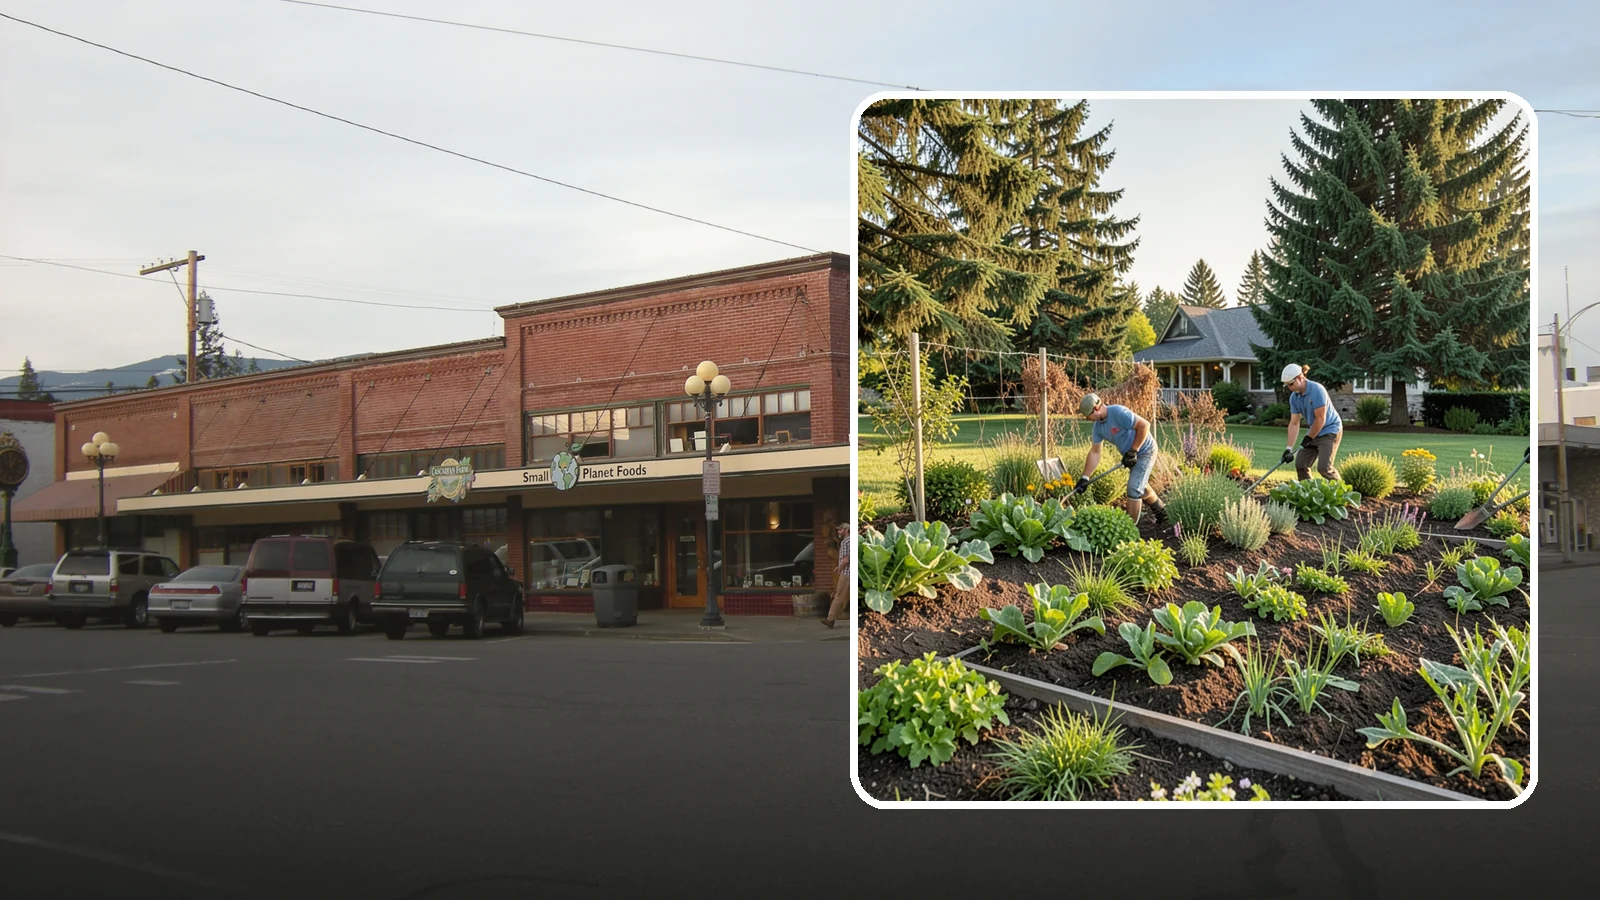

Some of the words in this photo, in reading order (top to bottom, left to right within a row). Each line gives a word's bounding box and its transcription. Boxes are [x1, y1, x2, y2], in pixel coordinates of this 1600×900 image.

[523, 471, 549, 482] Small
[583, 468, 614, 479] Planet
[617, 464, 647, 476] Foods
